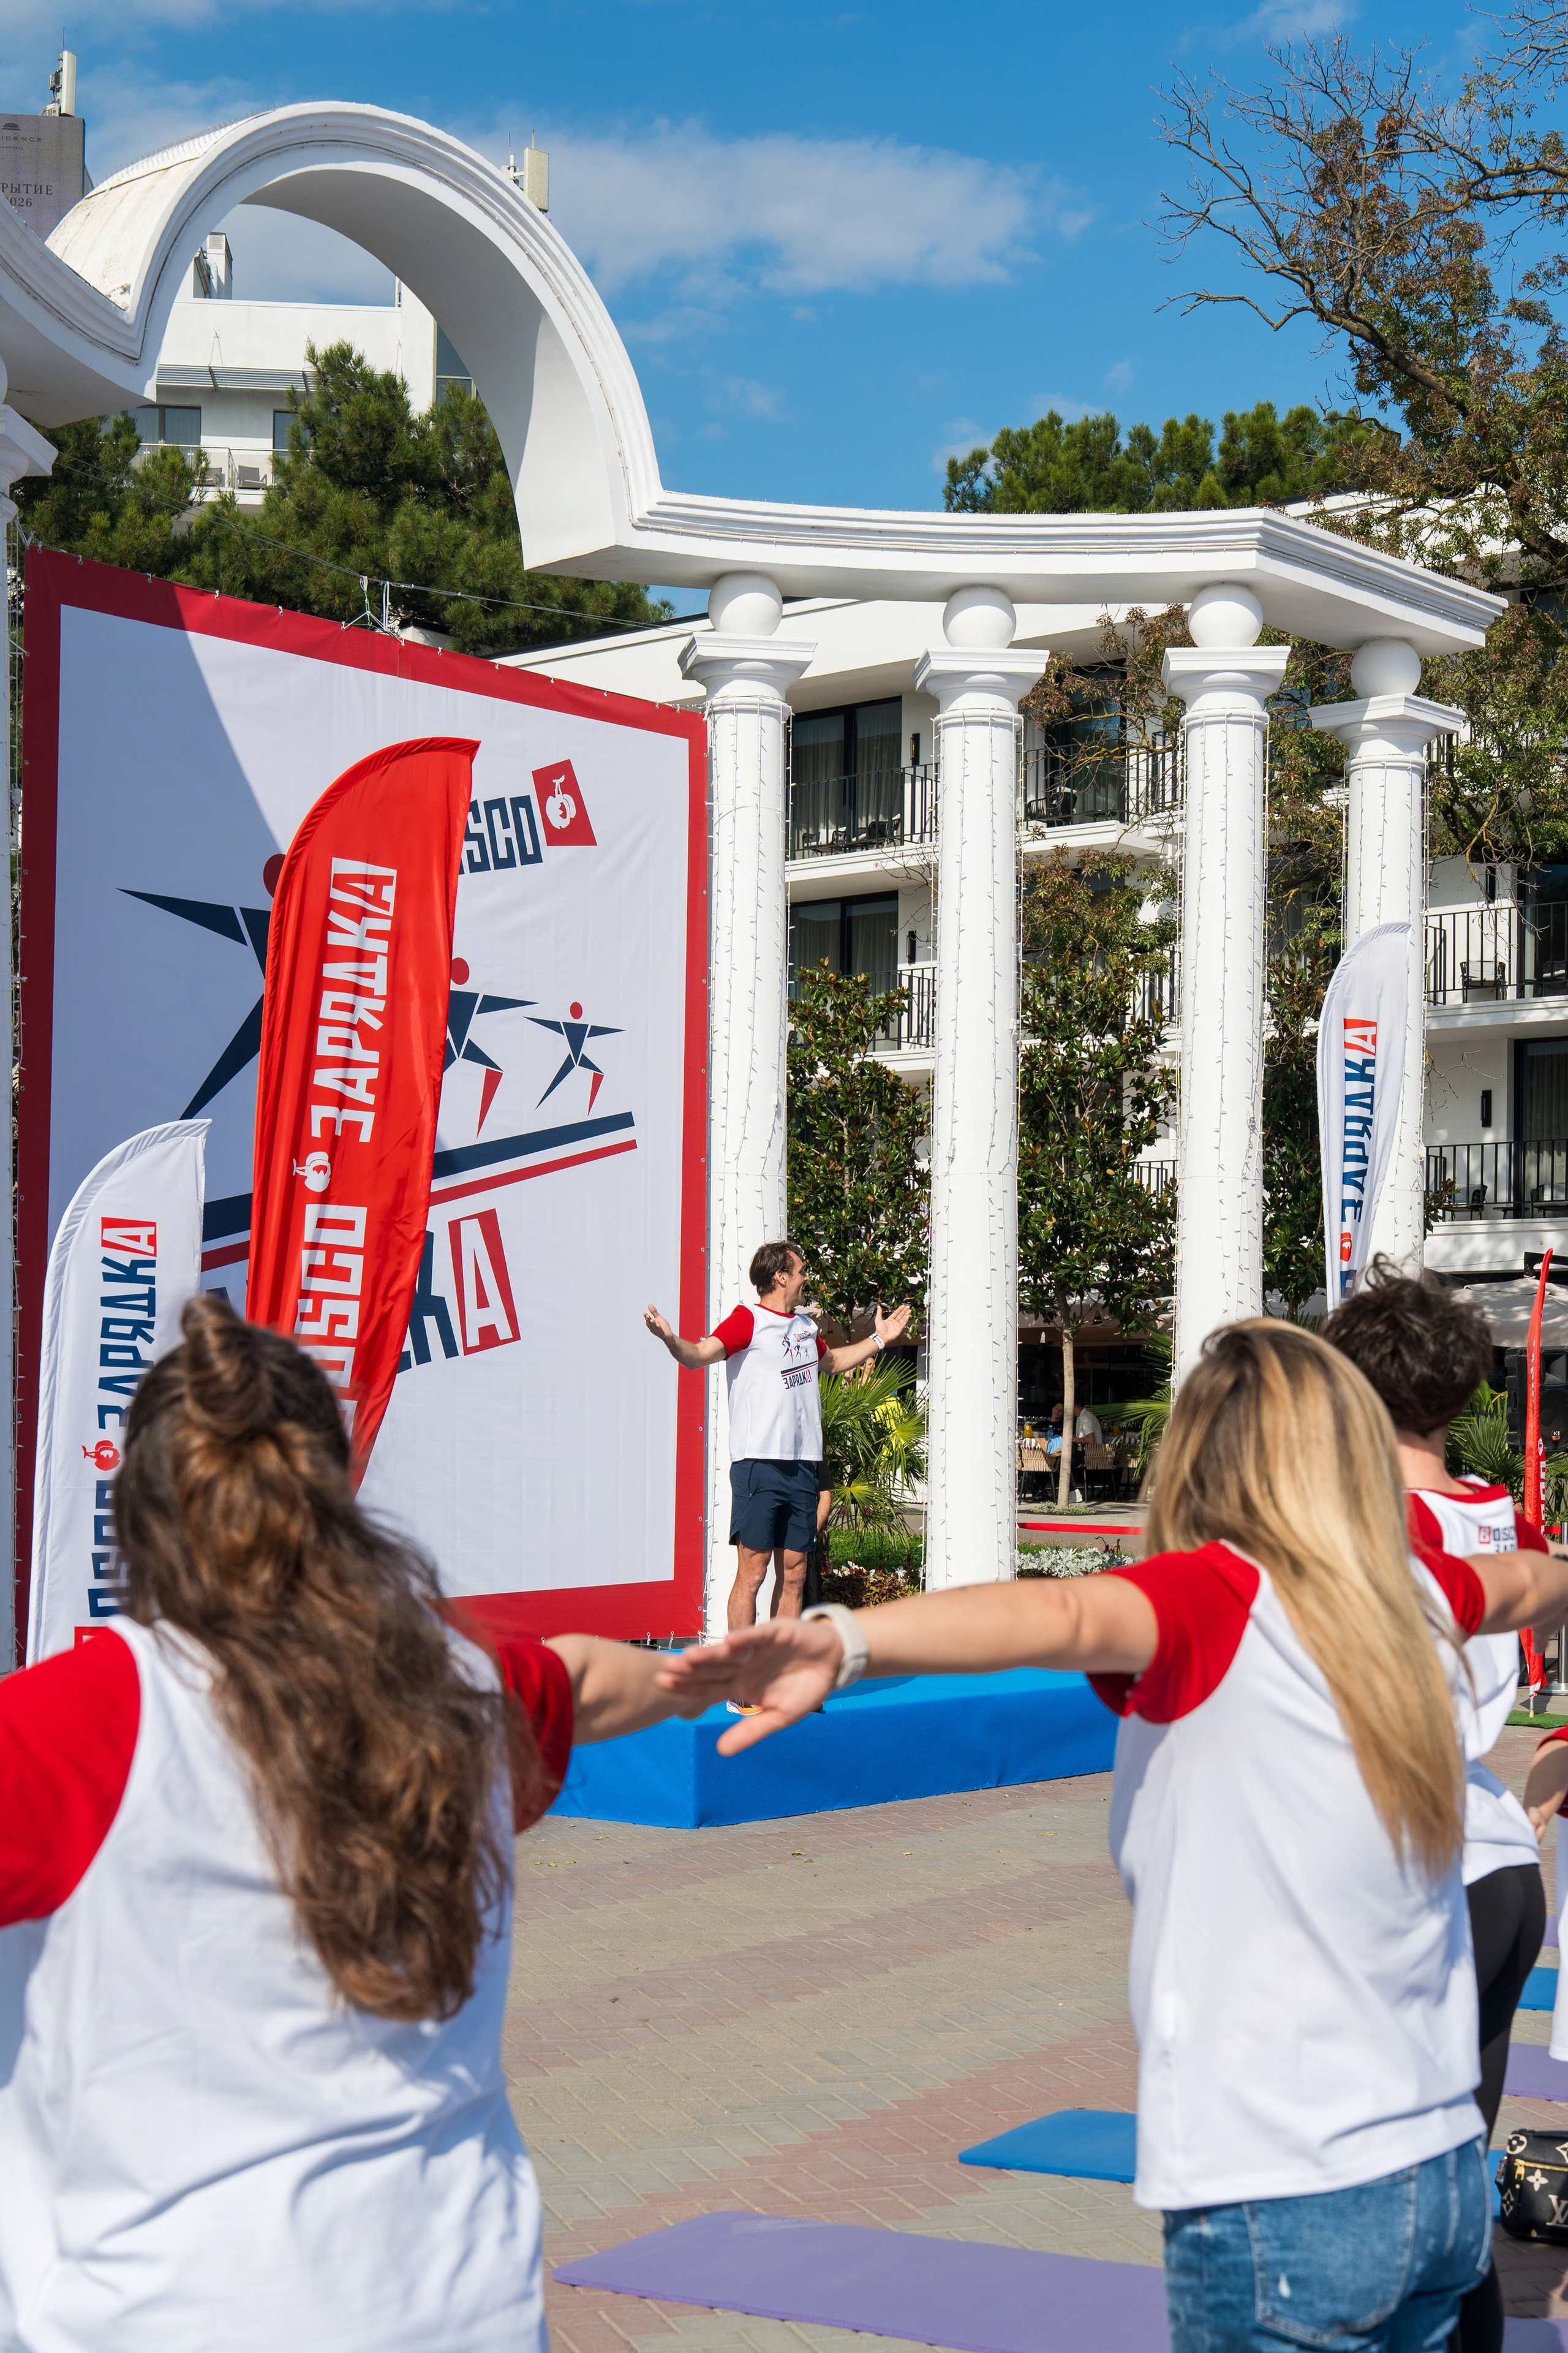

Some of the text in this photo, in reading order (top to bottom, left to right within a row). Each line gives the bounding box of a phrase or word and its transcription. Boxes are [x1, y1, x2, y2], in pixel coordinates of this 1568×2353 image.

[6, 197, 32, 207] 026
[459, 795, 543, 875] SCO
[311, 856, 398, 1144] ЗАРЯДКА
[1341, 1018, 1378, 1223] ЗАРЯДКА
[293, 1203, 368, 1443] OSCO
[783, 1369, 813, 1390] ЗАРЯДКА
